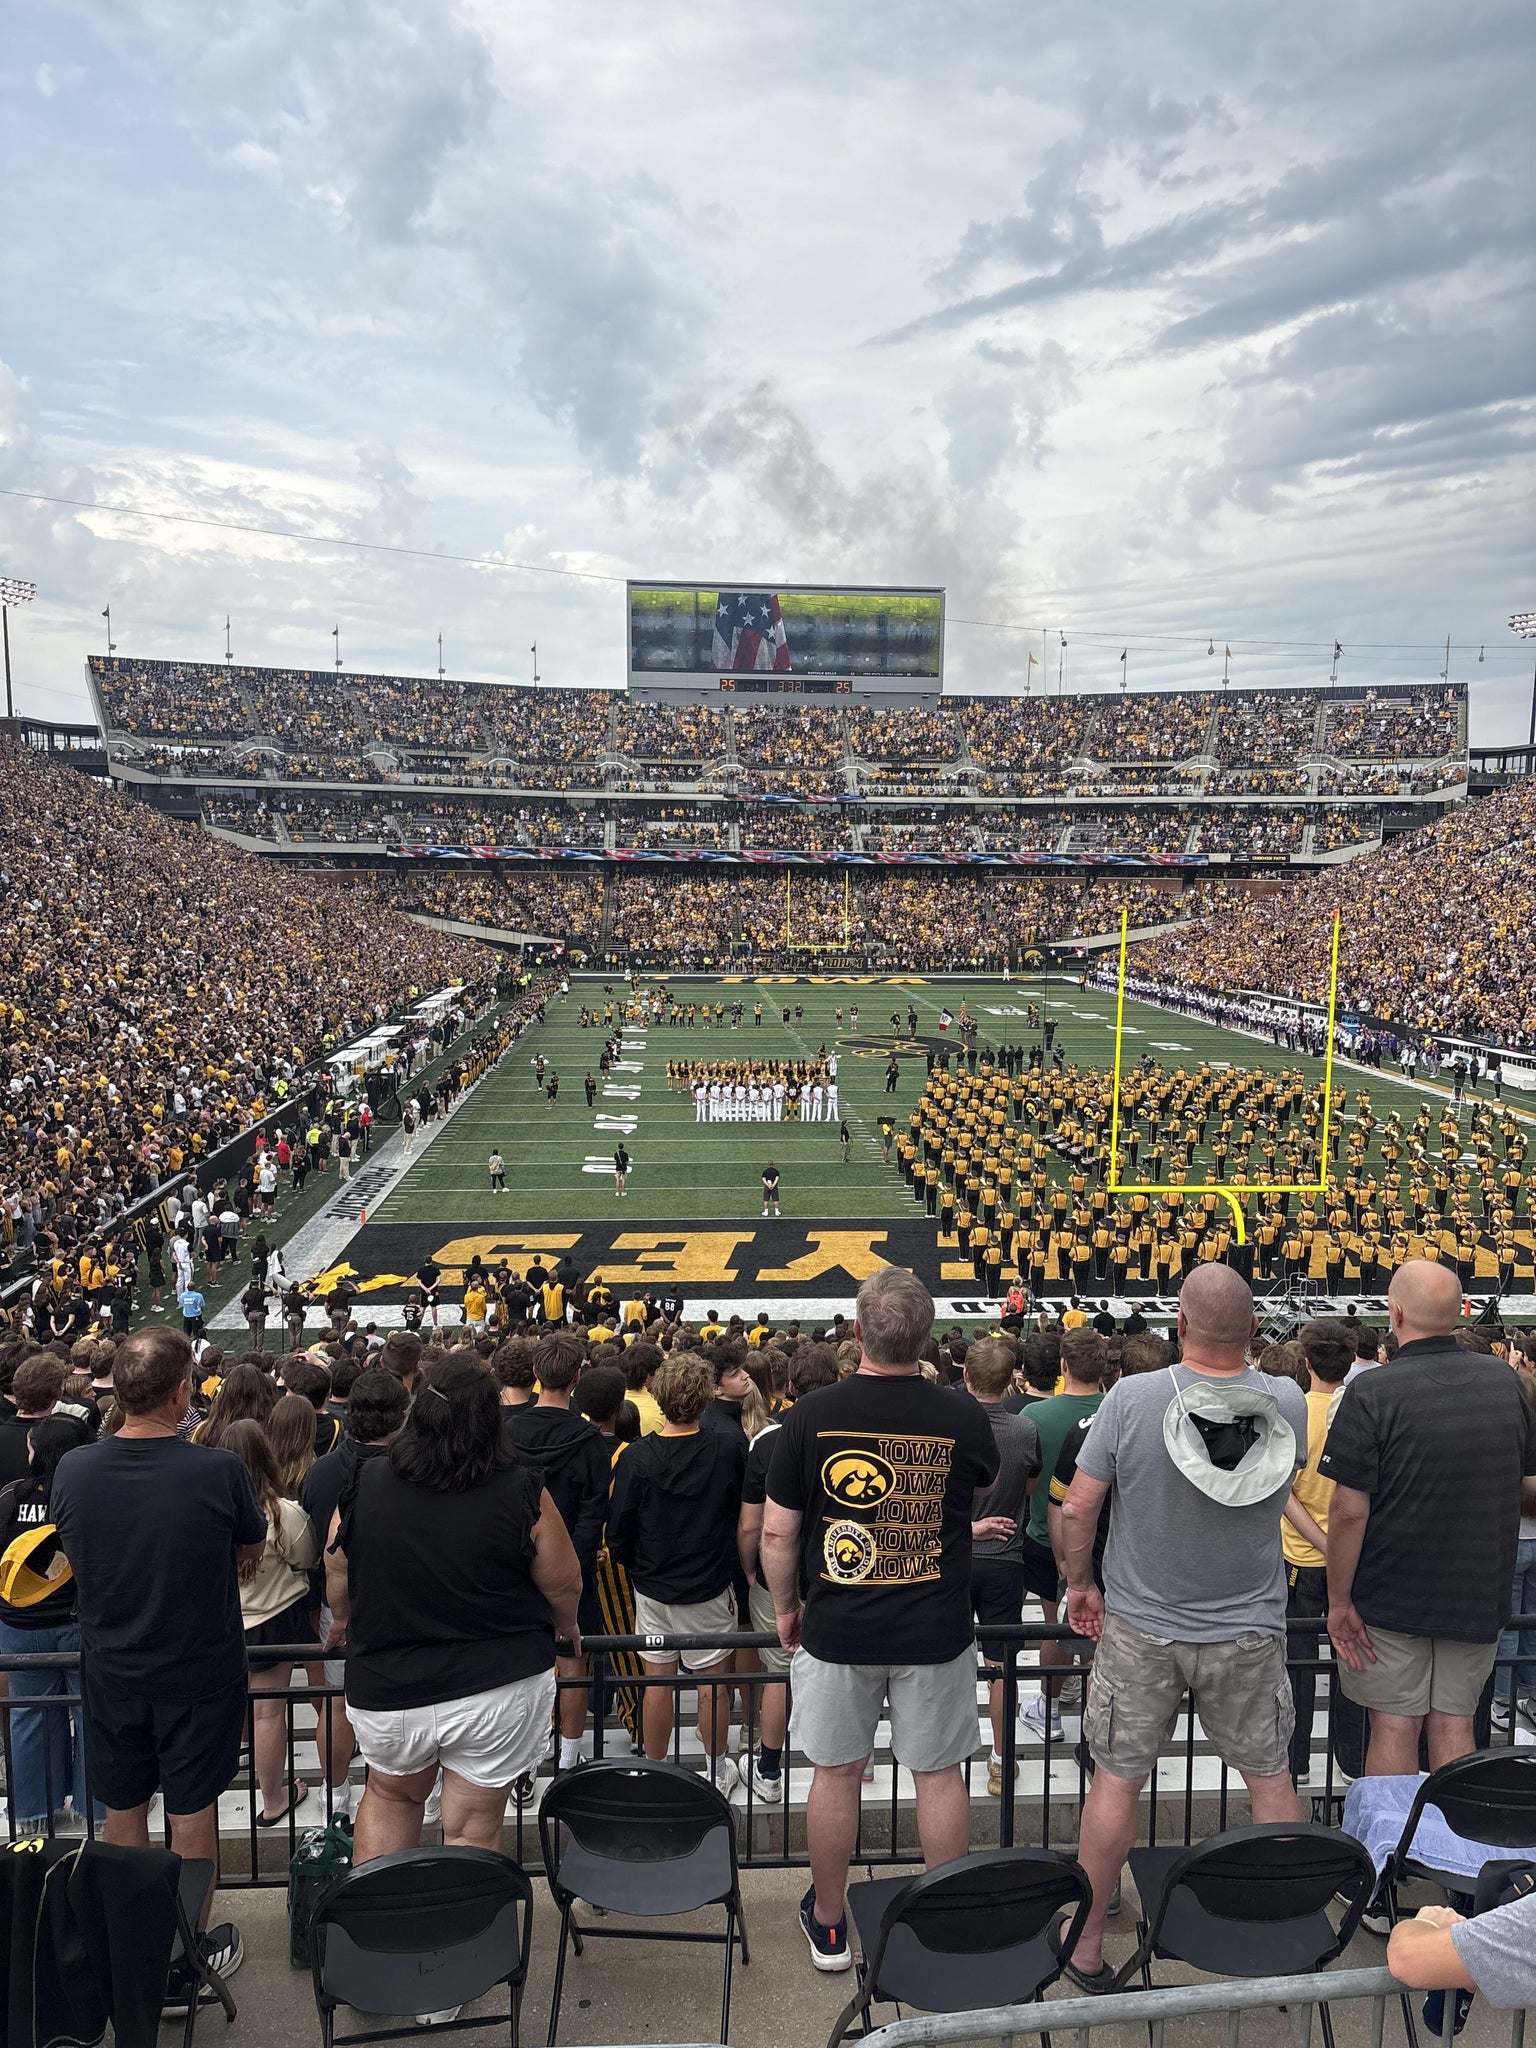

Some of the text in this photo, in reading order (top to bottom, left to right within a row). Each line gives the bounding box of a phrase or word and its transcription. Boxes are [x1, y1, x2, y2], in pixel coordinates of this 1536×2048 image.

[721, 680, 736, 691] 25
[778, 681, 802, 692] 3:32
[836, 682, 851, 693] 25
[715, 977, 932, 985] IOWA
[324, 1166, 398, 1221] PROGRESSIVE
[664, 1301, 675, 1311] 88
[878, 1440, 954, 1467] IOWA
[895, 1471, 949, 1495] OWA
[876, 1500, 943, 1523] IOWA
[874, 1526, 942, 1551] IOWA
[828, 1525, 872, 1577] THE UNIVERSITY OF IOWA
[872, 1554, 940, 1579] IOWA
[1288, 1566, 1299, 1587] IOWA
[648, 1636, 662, 1646] 10
